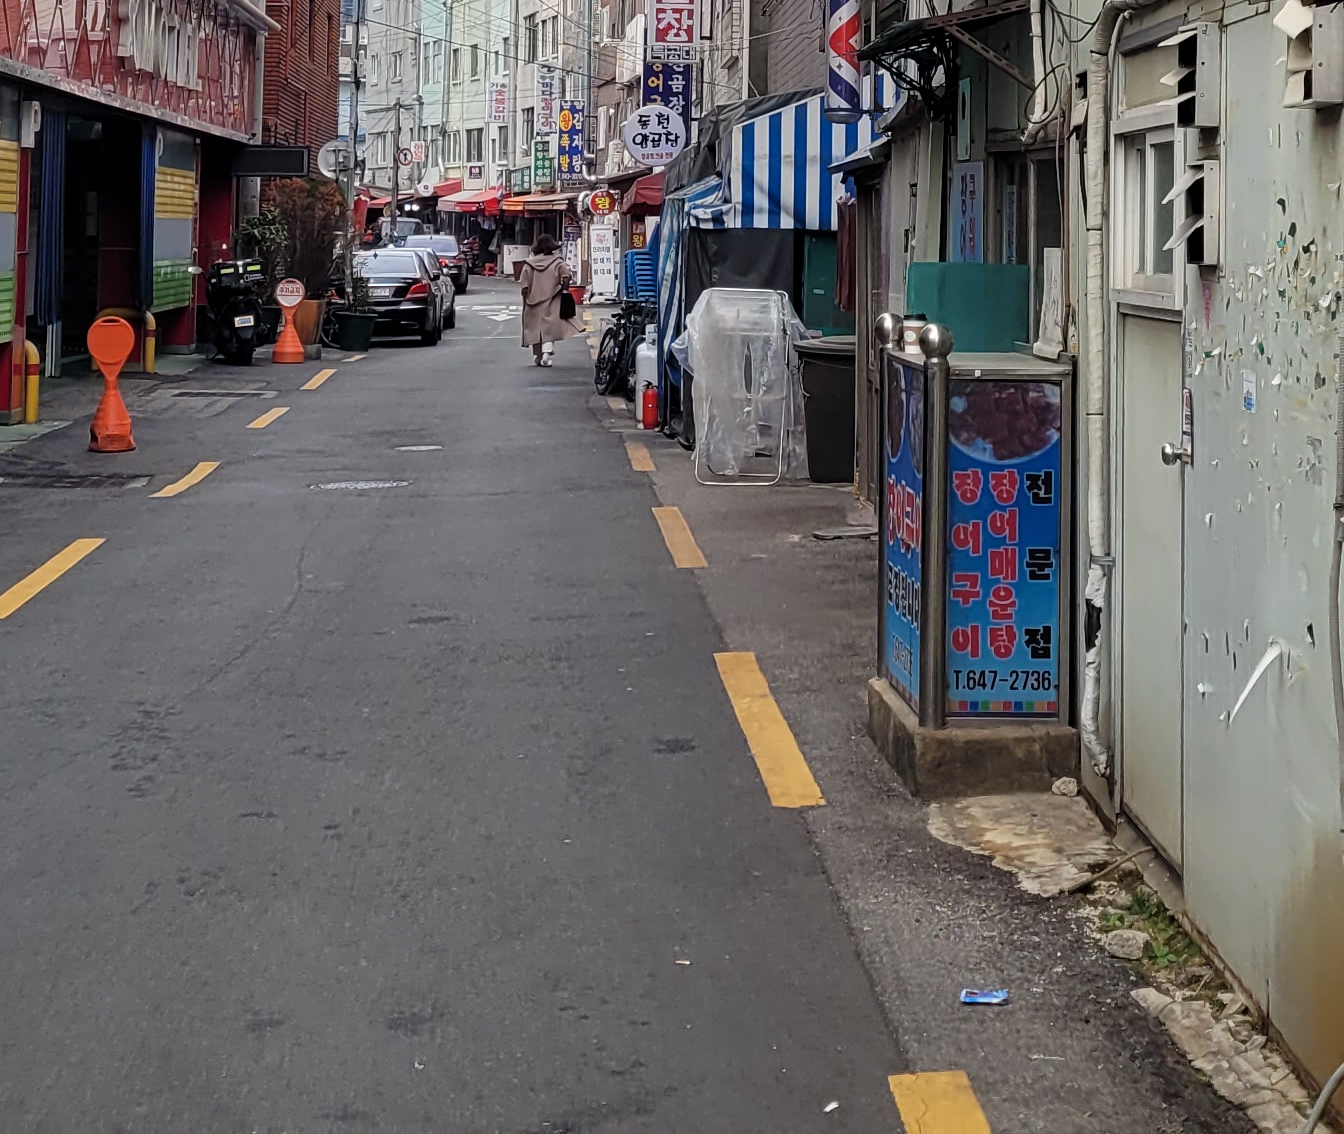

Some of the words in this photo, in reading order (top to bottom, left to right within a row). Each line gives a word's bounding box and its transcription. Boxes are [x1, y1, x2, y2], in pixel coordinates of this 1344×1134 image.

[951, 468, 983, 660] 장어구이
[987, 468, 1019, 660] 장어매운탕
[1023, 469, 1054, 660] 전문점
[952, 668, 1053, 692] T.647-2736
